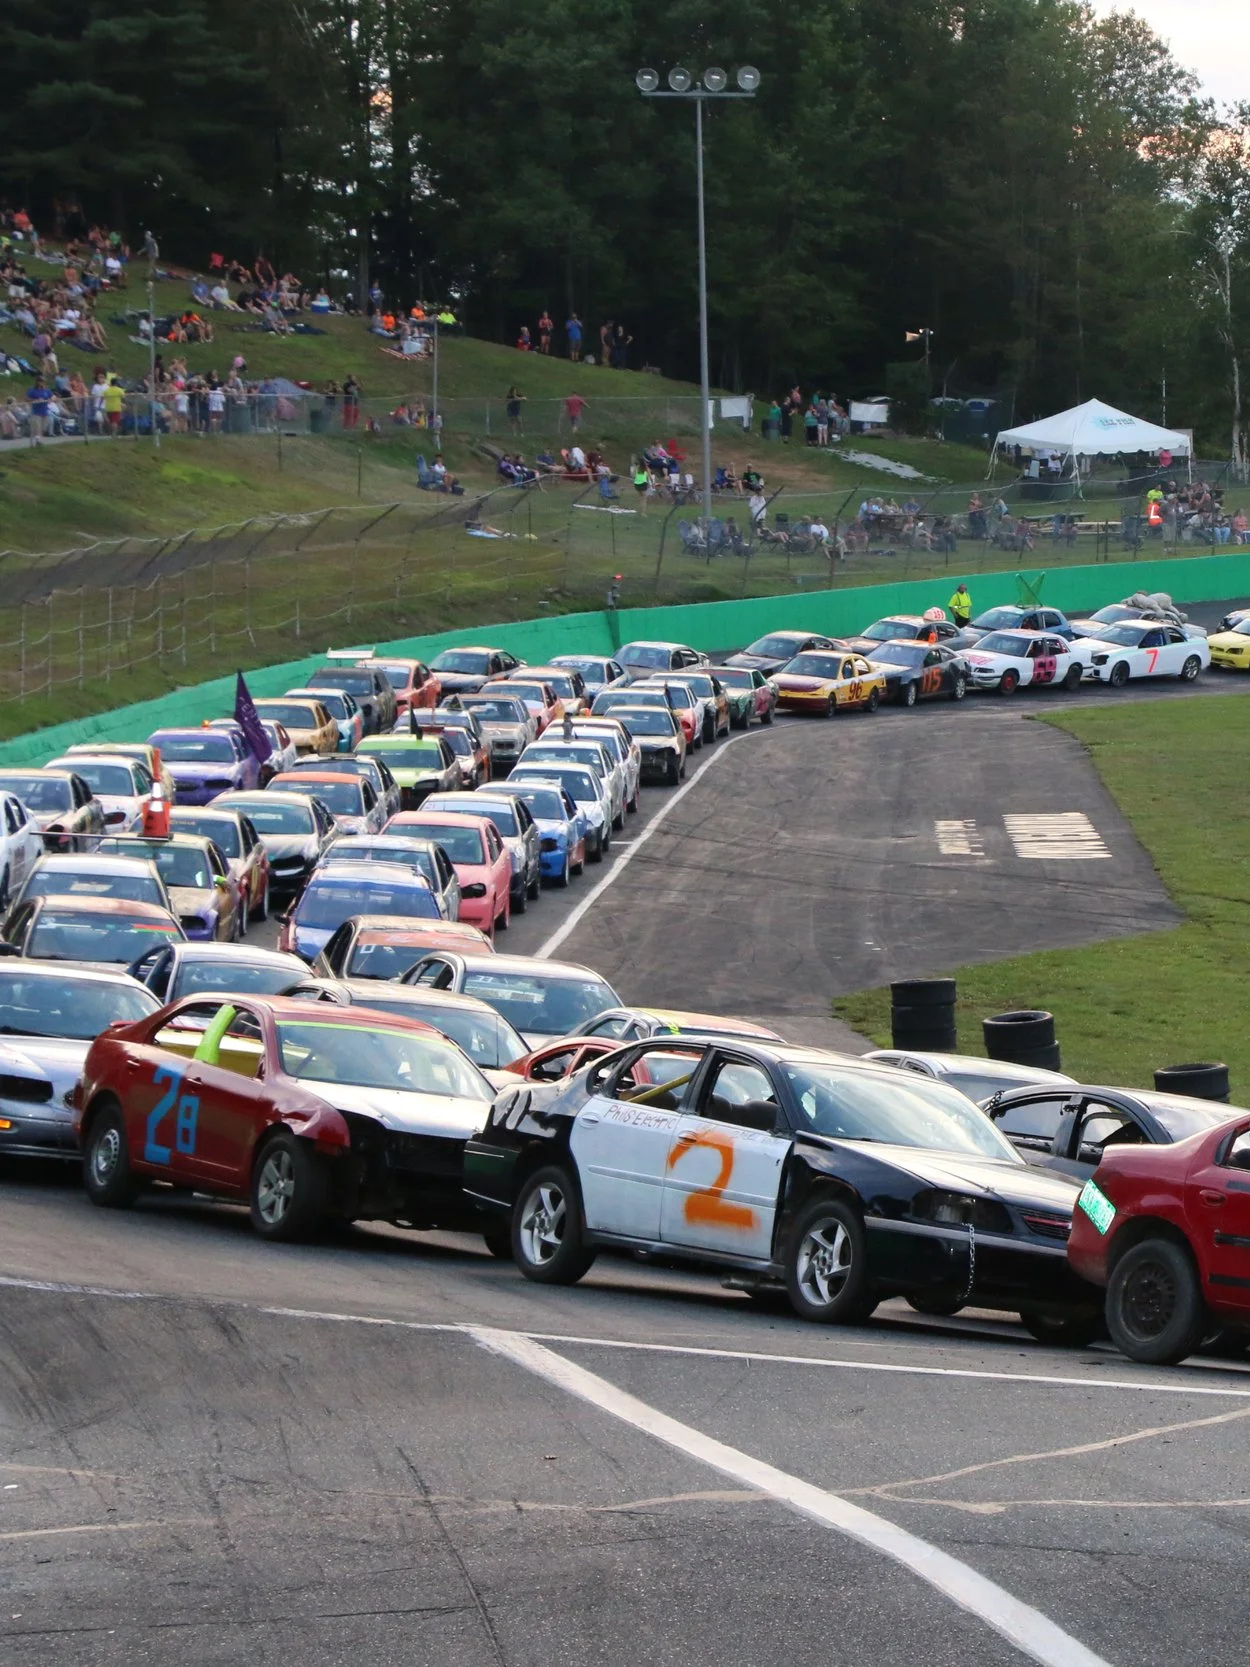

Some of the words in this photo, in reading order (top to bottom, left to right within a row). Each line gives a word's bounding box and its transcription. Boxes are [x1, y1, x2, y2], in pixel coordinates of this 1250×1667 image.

[848, 678, 863, 701] 96
[1144, 648, 1160, 673] 7
[144, 1062, 201, 1166] 28
[668, 1126, 757, 1231] 2
